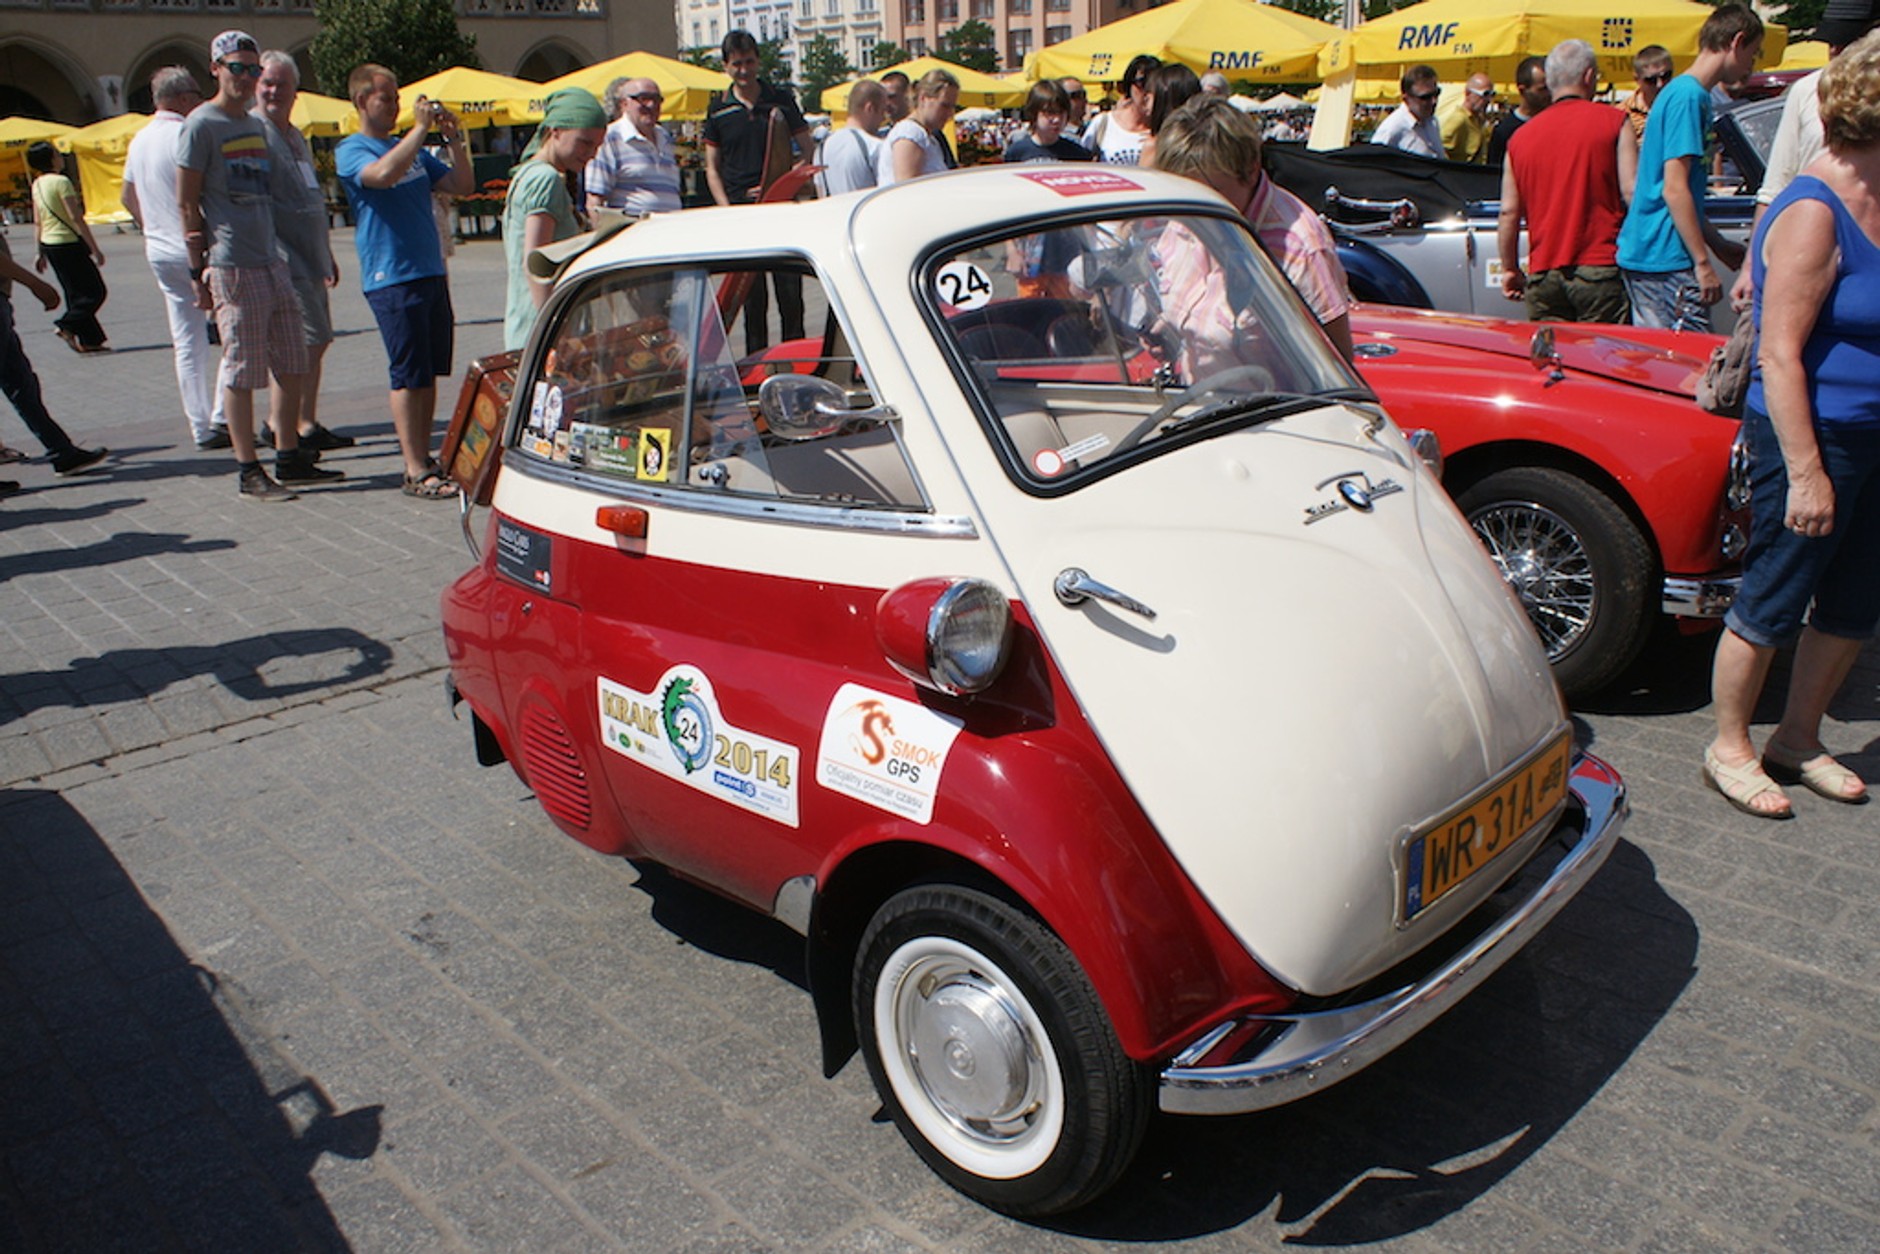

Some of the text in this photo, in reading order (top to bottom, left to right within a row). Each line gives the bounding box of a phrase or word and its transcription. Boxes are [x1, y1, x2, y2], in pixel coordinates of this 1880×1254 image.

[1397, 22, 1474, 55] RMF FM
[1209, 50, 1282, 76] RMF FM
[461, 100, 497, 115] RMF
[940, 265, 990, 306] 24
[602, 688, 660, 740] KRAK
[681, 717, 698, 743] 24
[714, 733, 791, 790] 2014
[890, 739, 942, 770] SMOK
[886, 758, 921, 784] GPS
[1431, 772, 1534, 894] WR 31A
